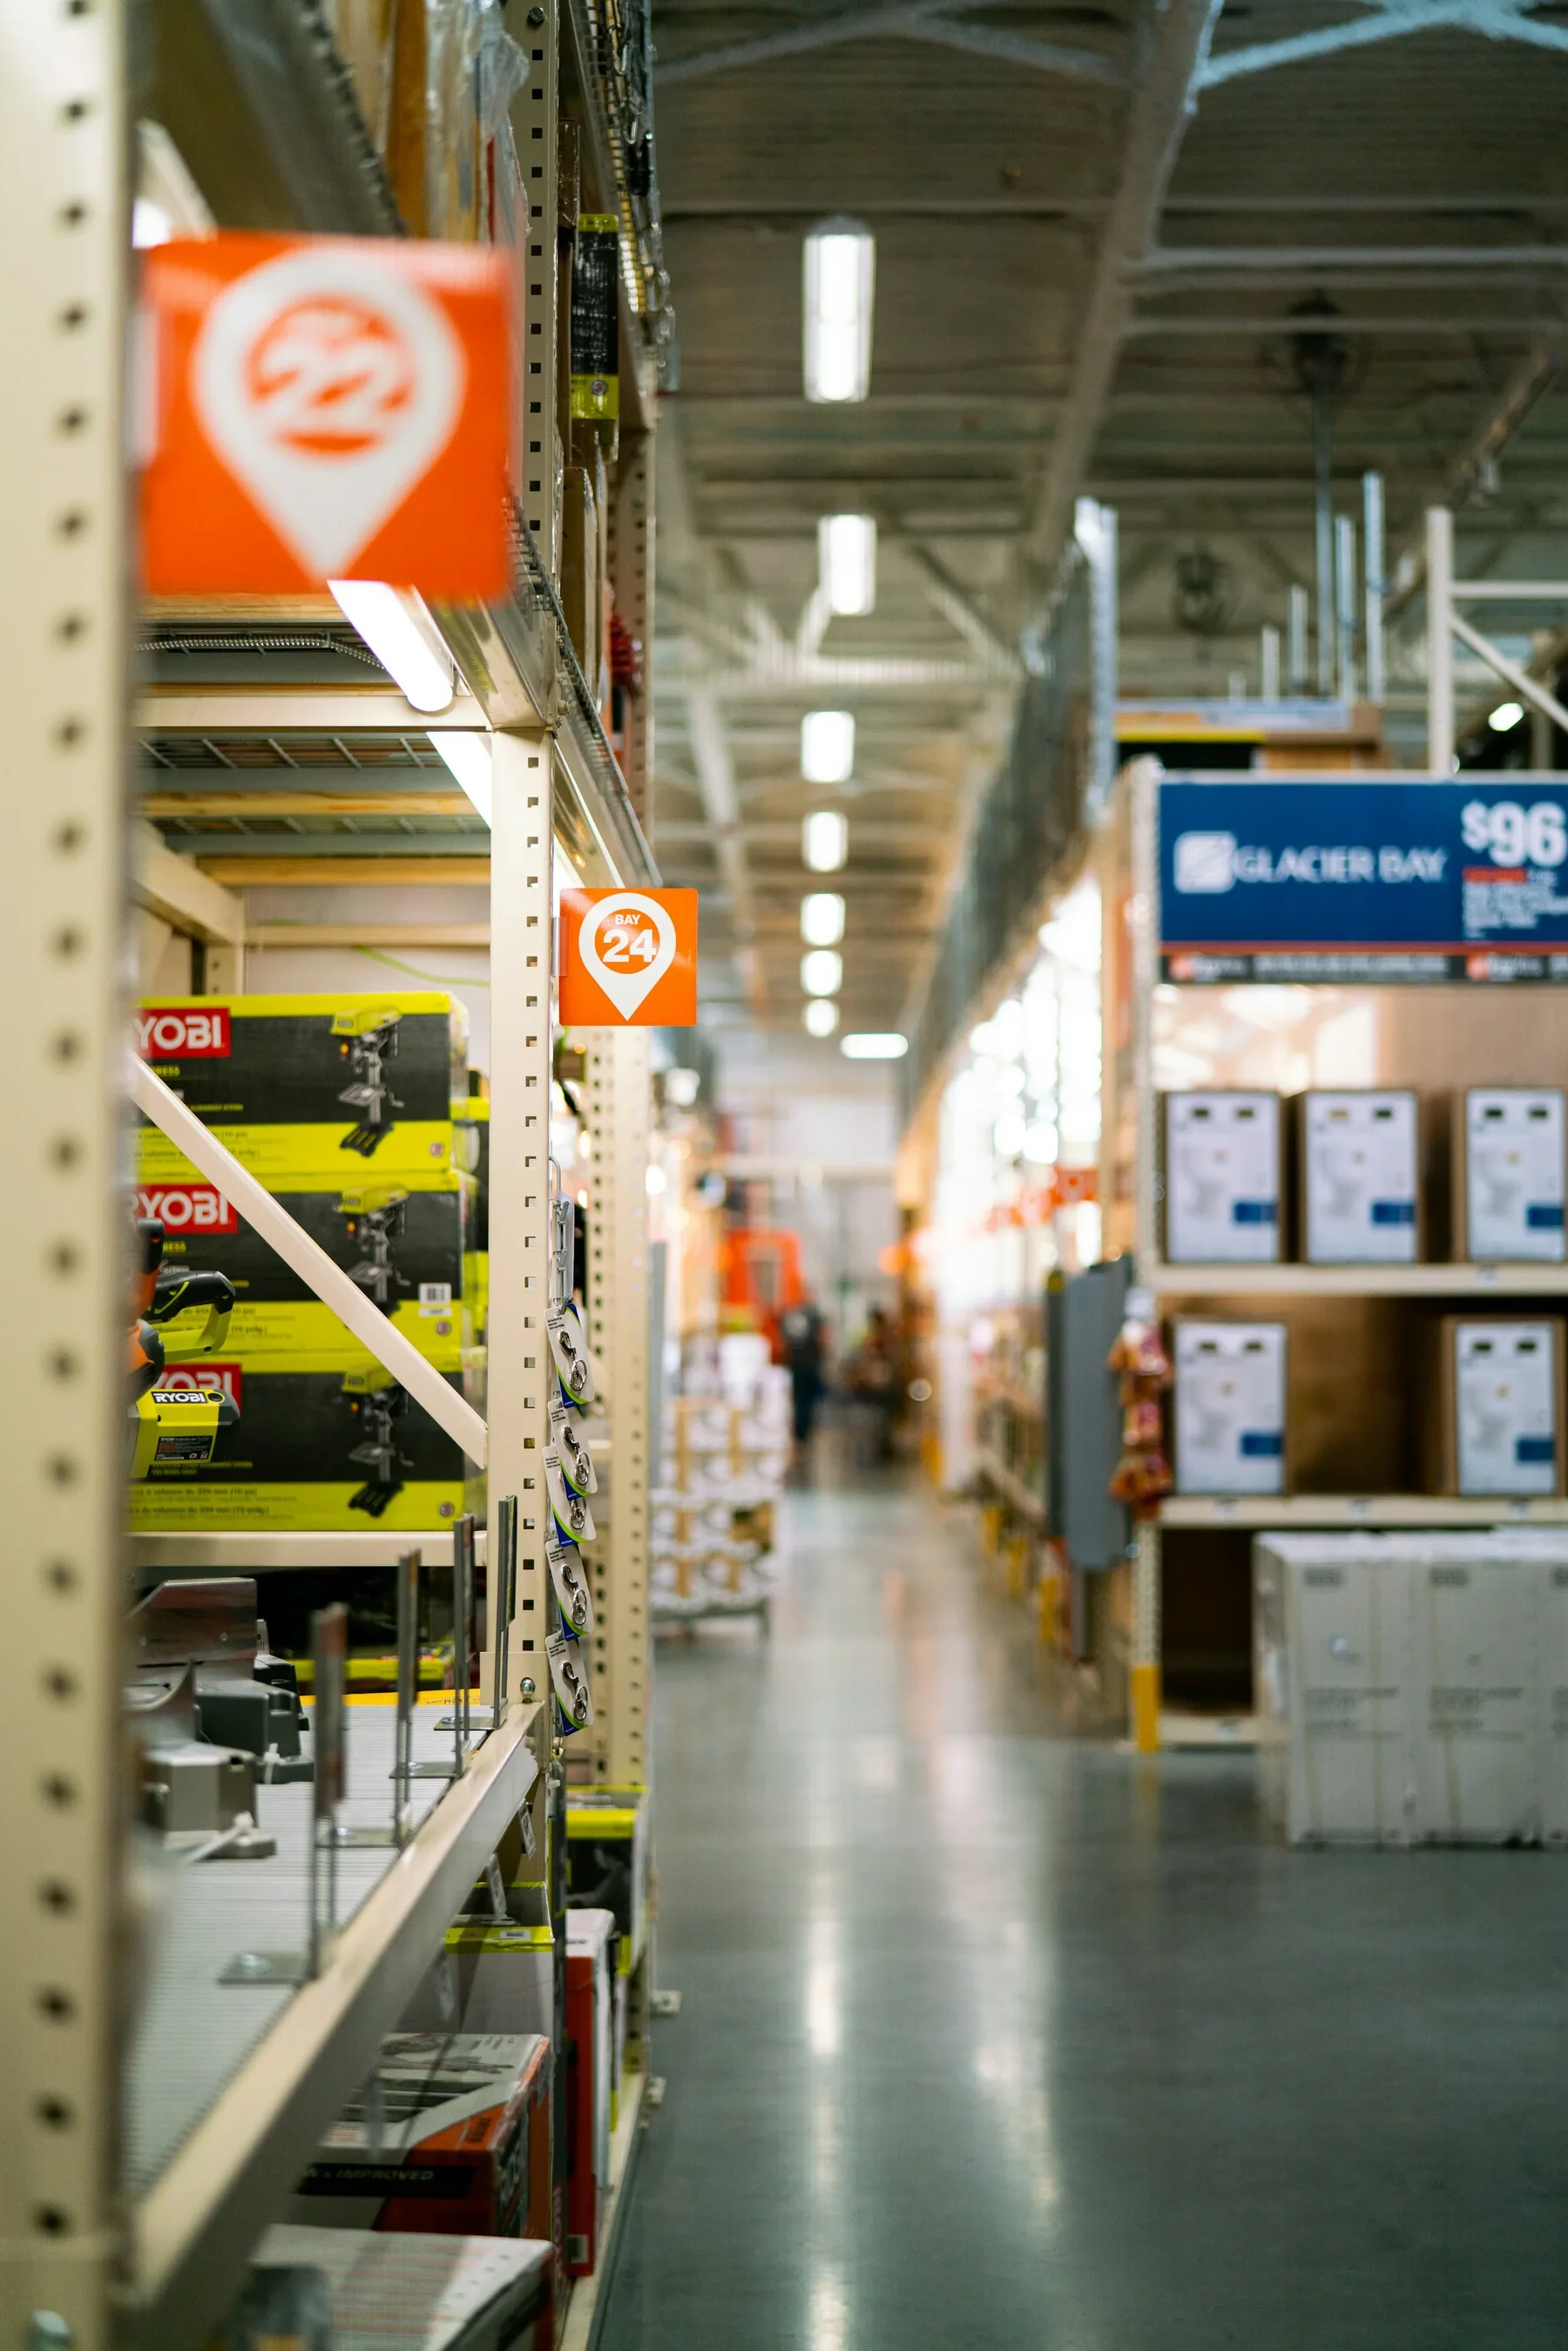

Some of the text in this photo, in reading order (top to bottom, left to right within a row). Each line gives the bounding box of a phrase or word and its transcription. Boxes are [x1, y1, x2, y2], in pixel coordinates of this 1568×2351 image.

[1462, 799, 1567, 868] $96
[1234, 845, 1447, 884] GLACIER BAY
[615, 914, 641, 925] BAY
[602, 929, 656, 963] 24
[132, 1015, 222, 1051] YOBI
[152, 1392, 206, 1404] RYOBI
[337, 2168, 436, 2180] IMPROVED
